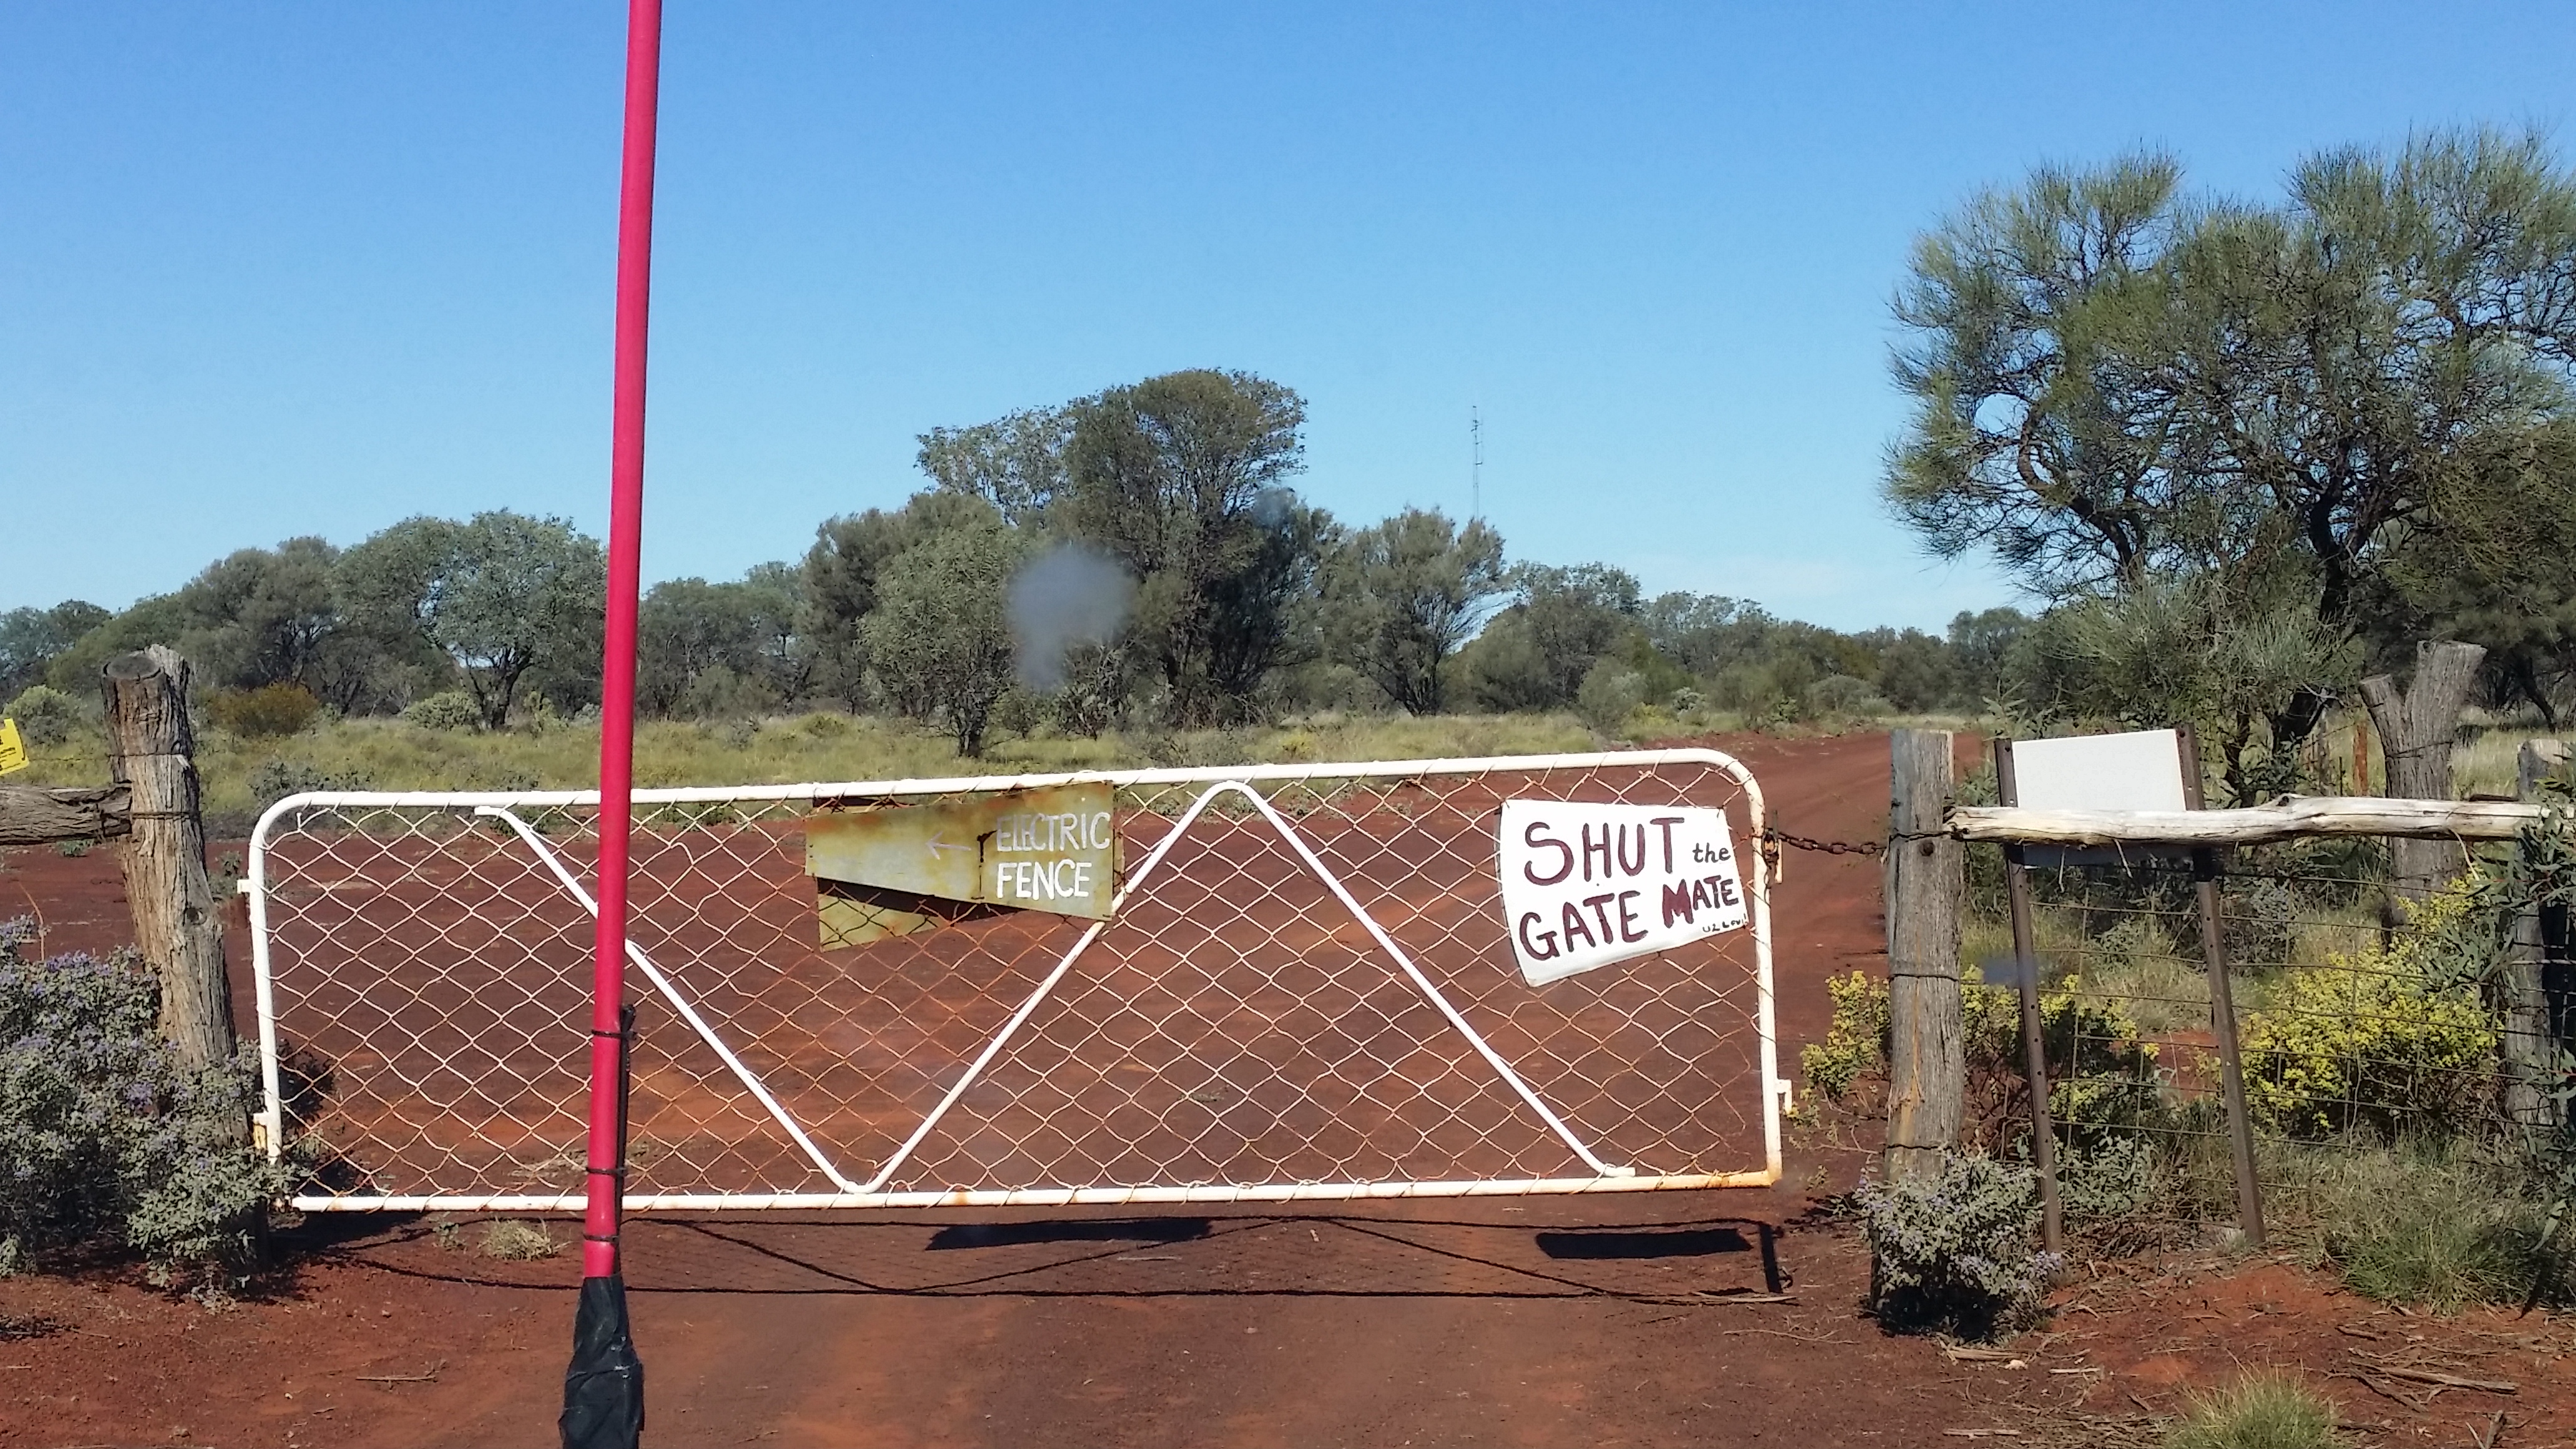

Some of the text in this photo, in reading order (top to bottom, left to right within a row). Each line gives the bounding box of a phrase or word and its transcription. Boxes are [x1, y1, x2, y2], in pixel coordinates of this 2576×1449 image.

[997, 812, 1111, 852] ELECTRIC
[1524, 817, 1732, 886] SHUT the
[997, 858, 1092, 900] FENCE
[1519, 874, 1739, 960] GATE MATE
